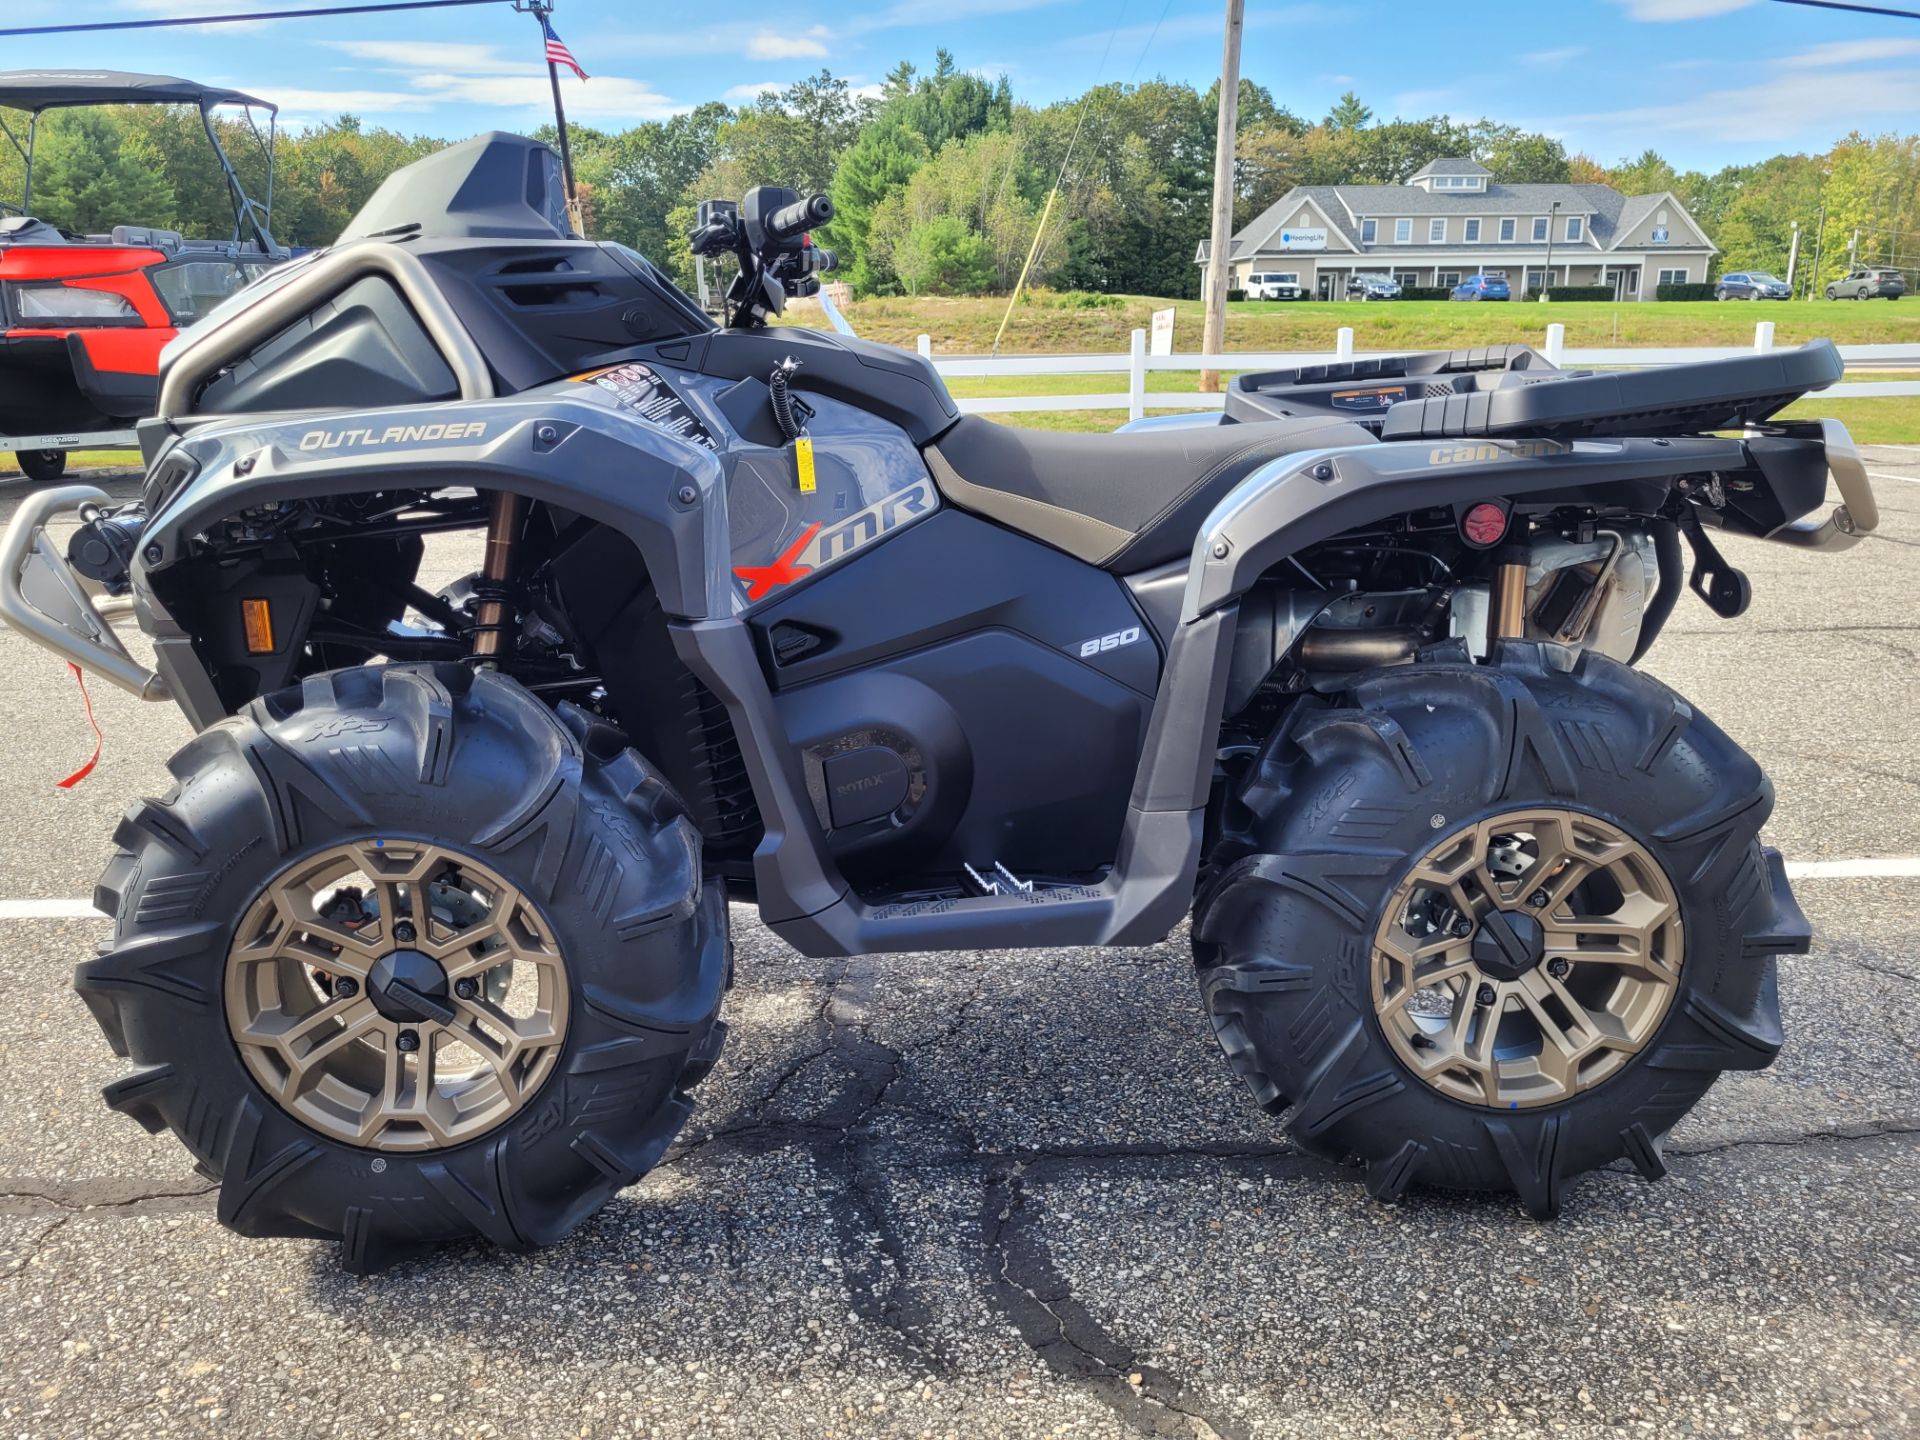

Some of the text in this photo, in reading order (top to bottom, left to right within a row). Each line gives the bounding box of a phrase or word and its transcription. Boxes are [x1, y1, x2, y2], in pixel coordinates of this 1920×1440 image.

[1291, 234, 1325, 243] HearingLife
[300, 422, 487, 450] OUTLANDER
[1080, 627, 1140, 657] 850
[305, 715, 396, 743] XPS
[836, 774, 884, 796] ROTAX
[588, 800, 650, 862] XPS
